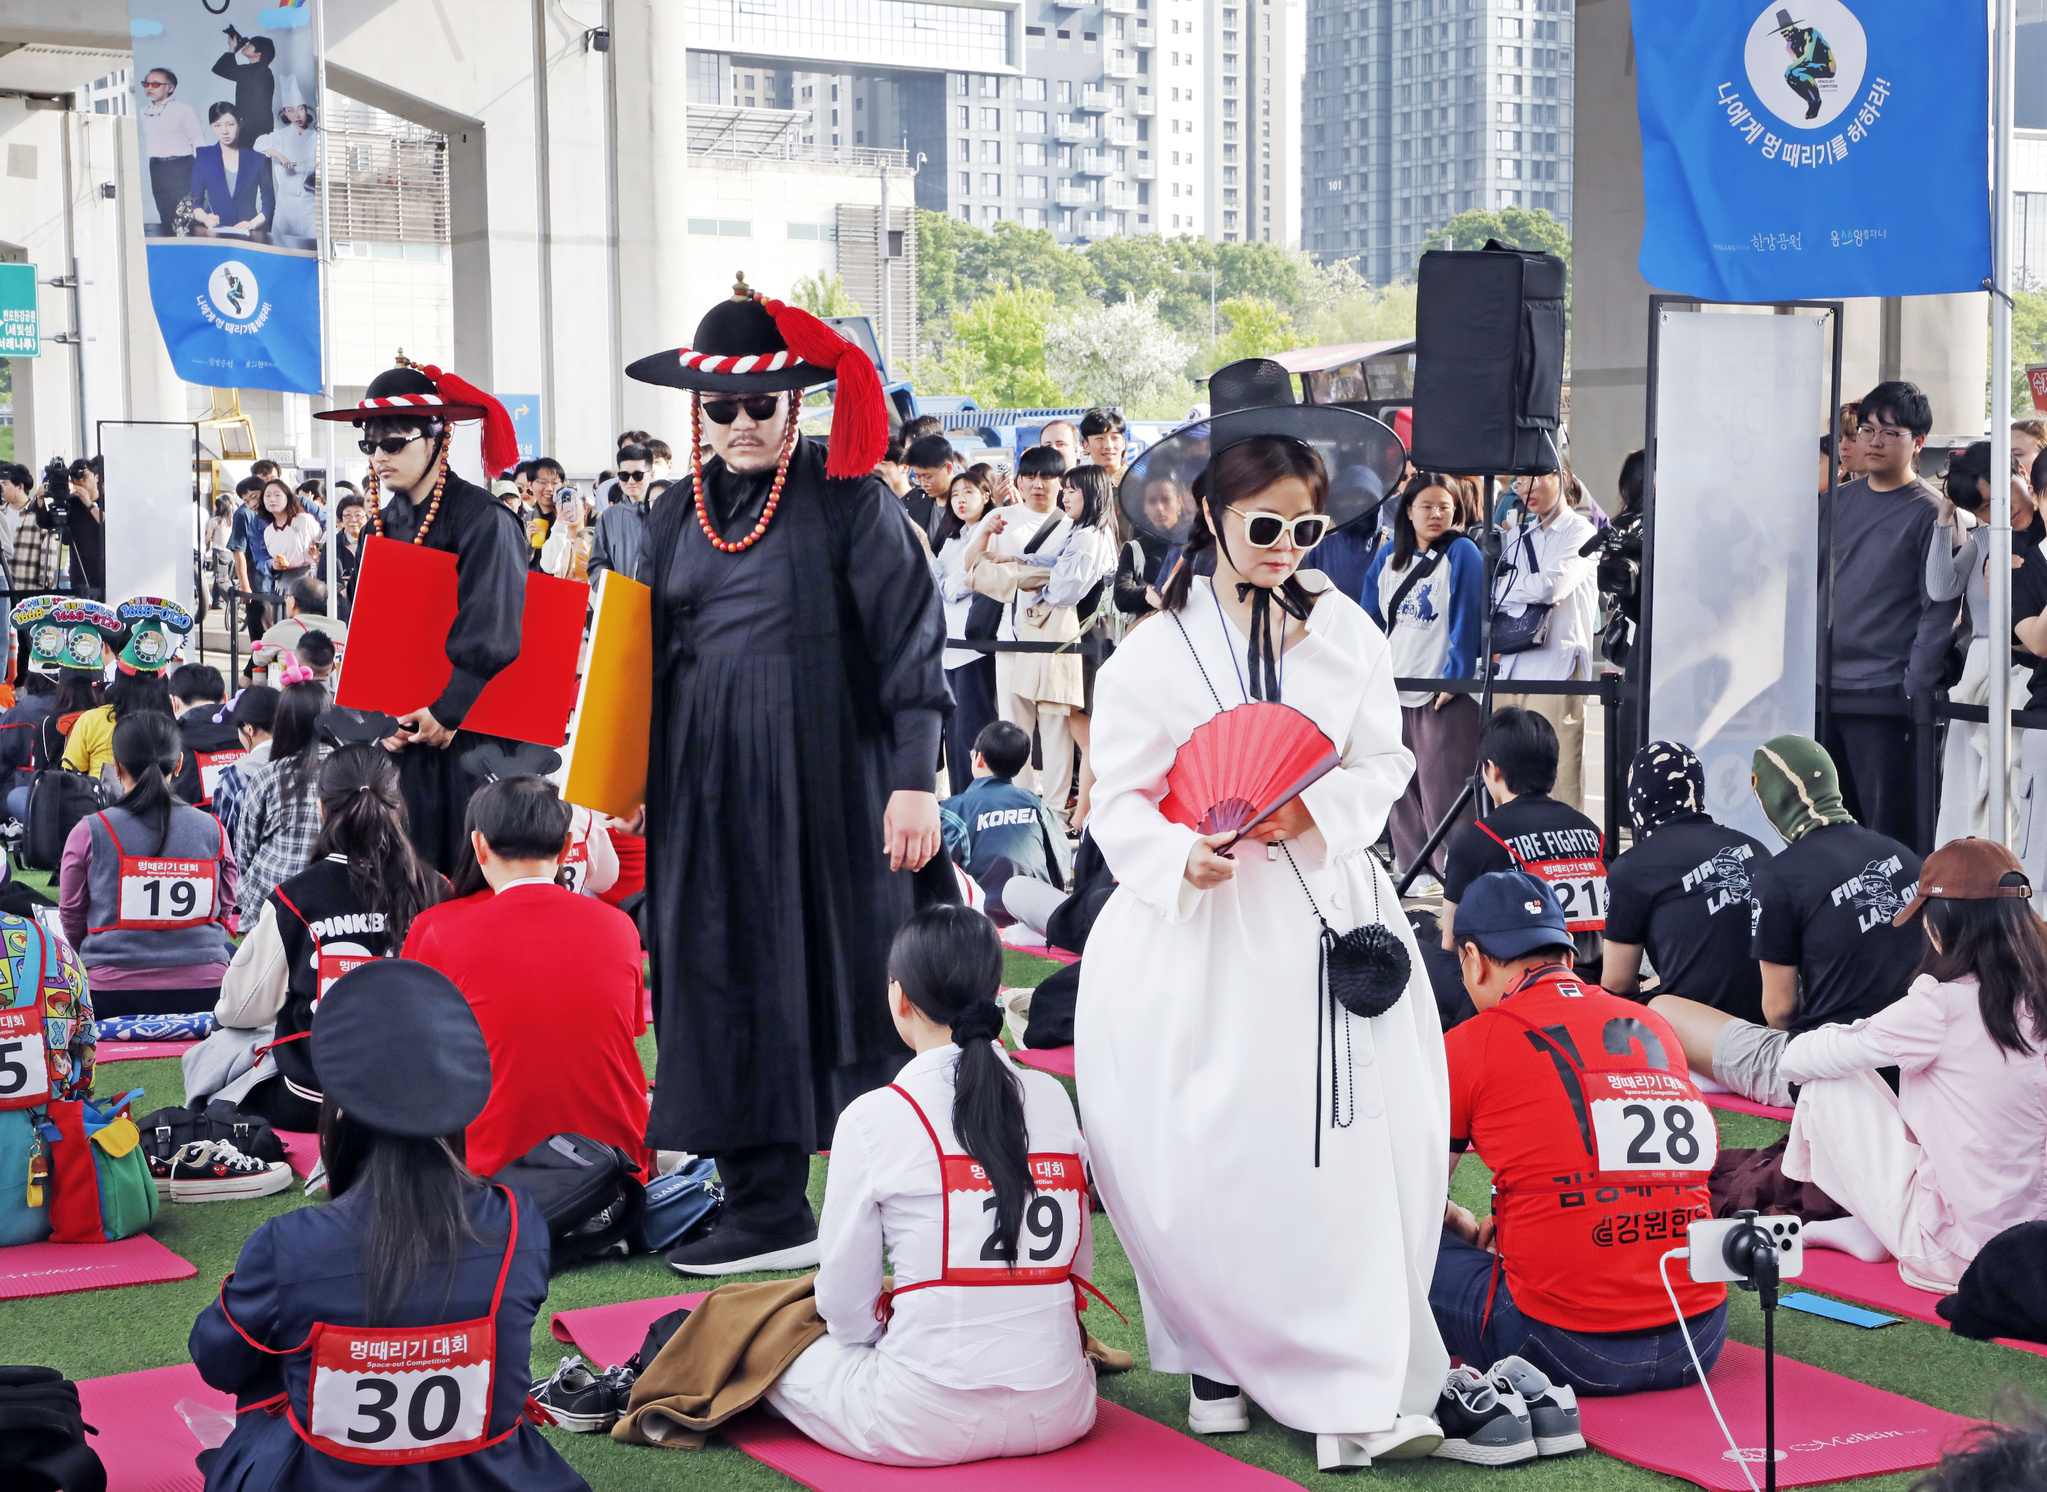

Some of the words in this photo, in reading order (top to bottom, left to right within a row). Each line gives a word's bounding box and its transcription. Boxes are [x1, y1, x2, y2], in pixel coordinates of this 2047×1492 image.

[1718, 81, 1765, 144] 나에게
[1761, 132, 1782, 159] 멍
[1782, 133, 1849, 168] 때리기를
[1847, 77, 1891, 143] 허하라!
[1751, 232, 1802, 252] 한강공원
[3, 309, 36, 322] 반포한강공원
[196, 294, 216, 323] 나에게
[5, 322, 35, 337] (세빛섬)
[14, 607, 51, 625] 1668-
[53, 610, 121, 631] 1668-0120
[121, 605, 190, 628] 1668-0120
[976, 807, 1039, 832] KOREA
[1504, 833, 1546, 864] FIRE
[1543, 828, 1601, 854] FIGHTER
[138, 861, 177, 872] 멍때리기
[179, 863, 199, 873] 대회
[1543, 863, 1579, 875] 멍때리기
[1579, 862, 1597, 872] 대회
[1681, 860, 1716, 892] FIR
[143, 880, 197, 917] 19
[1553, 880, 1599, 918] 21
[1830, 877, 1864, 907] FIR
[0, 1014, 26, 1028] 대회
[0, 1041, 28, 1095] 5
[1607, 1075, 1662, 1090] 멍때리기
[1662, 1076, 1687, 1092] 대회
[1622, 1104, 1700, 1165] 28
[1036, 1161, 1065, 1178] 대회
[651, 1179, 691, 1200] GANNI
[980, 1195, 1064, 1262] 29
[350, 1339, 427, 1361] 멍때리기
[432, 1334, 468, 1356] 대회
[366, 1360, 405, 1369] Space-out
[406, 1357, 451, 1368] Competition
[347, 1374, 462, 1444] 30
